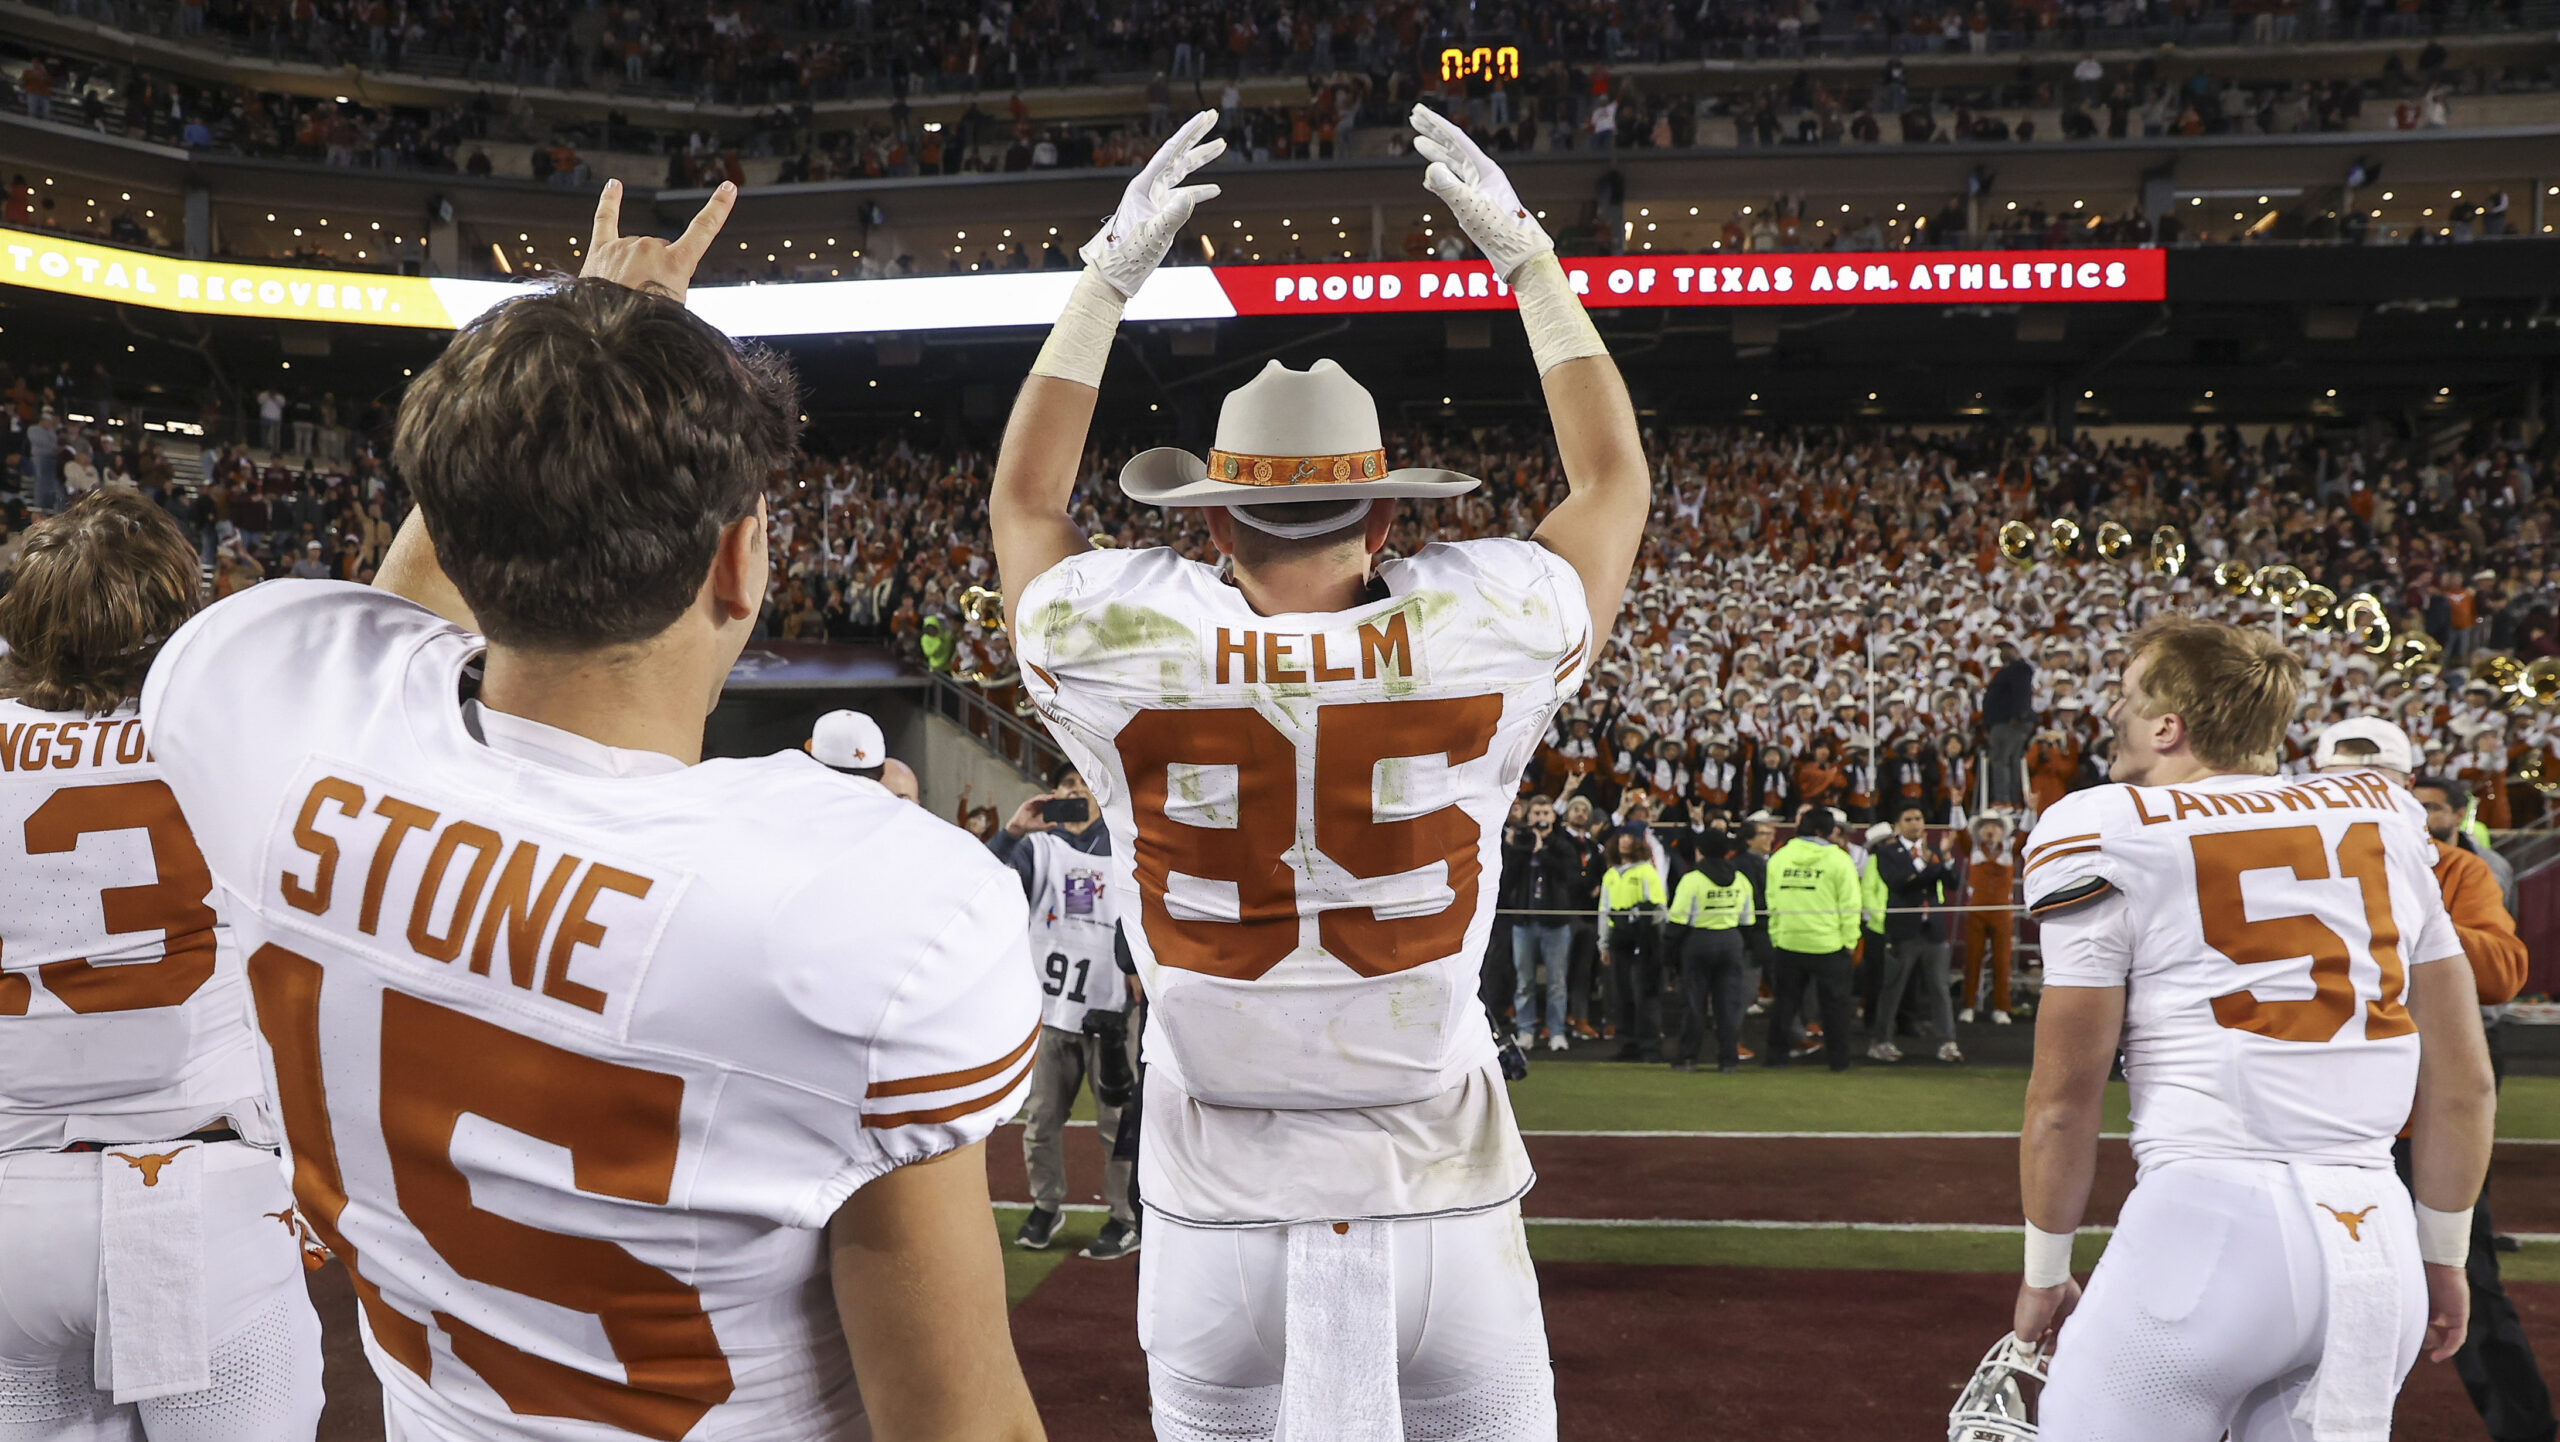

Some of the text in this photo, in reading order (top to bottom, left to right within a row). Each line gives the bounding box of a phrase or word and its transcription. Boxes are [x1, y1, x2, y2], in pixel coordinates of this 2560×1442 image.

[7, 244, 402, 313] TOTAL RECOVERY.
[1274, 274, 1402, 302] PROUD
[1419, 271, 1590, 299] PARTR
[1607, 267, 1657, 294] OF
[1672, 266, 1794, 293] TEXAS
[1909, 262, 2128, 290] ATHLETICS
[1216, 611, 1413, 684] HELM
[0, 720, 156, 772] NGSTO
[2123, 772, 2400, 826] LANDWEHR
[1113, 692, 1504, 982] 85
[0, 779, 218, 1016] 3
[280, 774, 655, 1016] STONE
[1706, 888, 1741, 900] BEST
[1781, 867, 1826, 880] BEST
[2189, 822, 2420, 1043] 51
[1042, 951, 1092, 1004] 91
[247, 940, 736, 1442] 15
